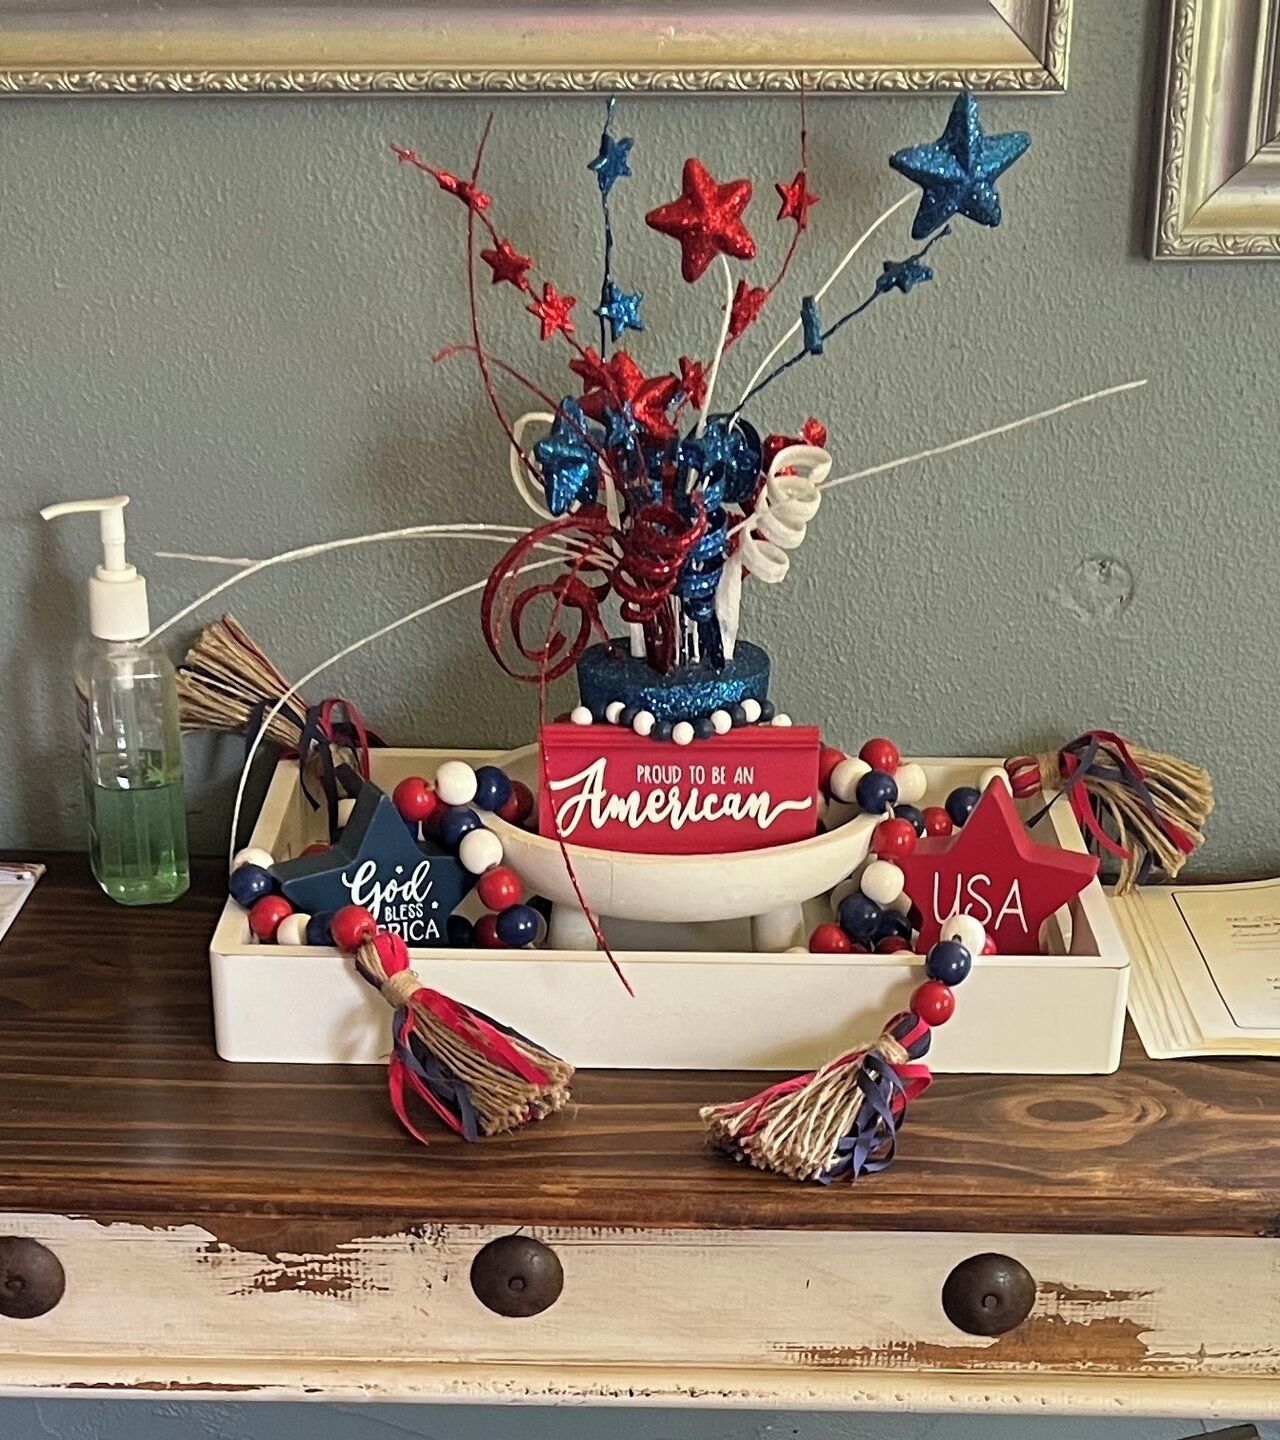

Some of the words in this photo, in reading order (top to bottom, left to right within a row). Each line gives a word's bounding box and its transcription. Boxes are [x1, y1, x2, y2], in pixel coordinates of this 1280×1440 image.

[549, 757, 812, 837] American
[636, 764, 682, 784] PROUD
[689, 764, 706, 785] TO
[712, 765, 727, 785] BE
[733, 766, 754, 785] AN
[341, 860, 433, 921] God
[384, 903, 424, 922] BLESS
[933, 871, 1028, 933] USA
